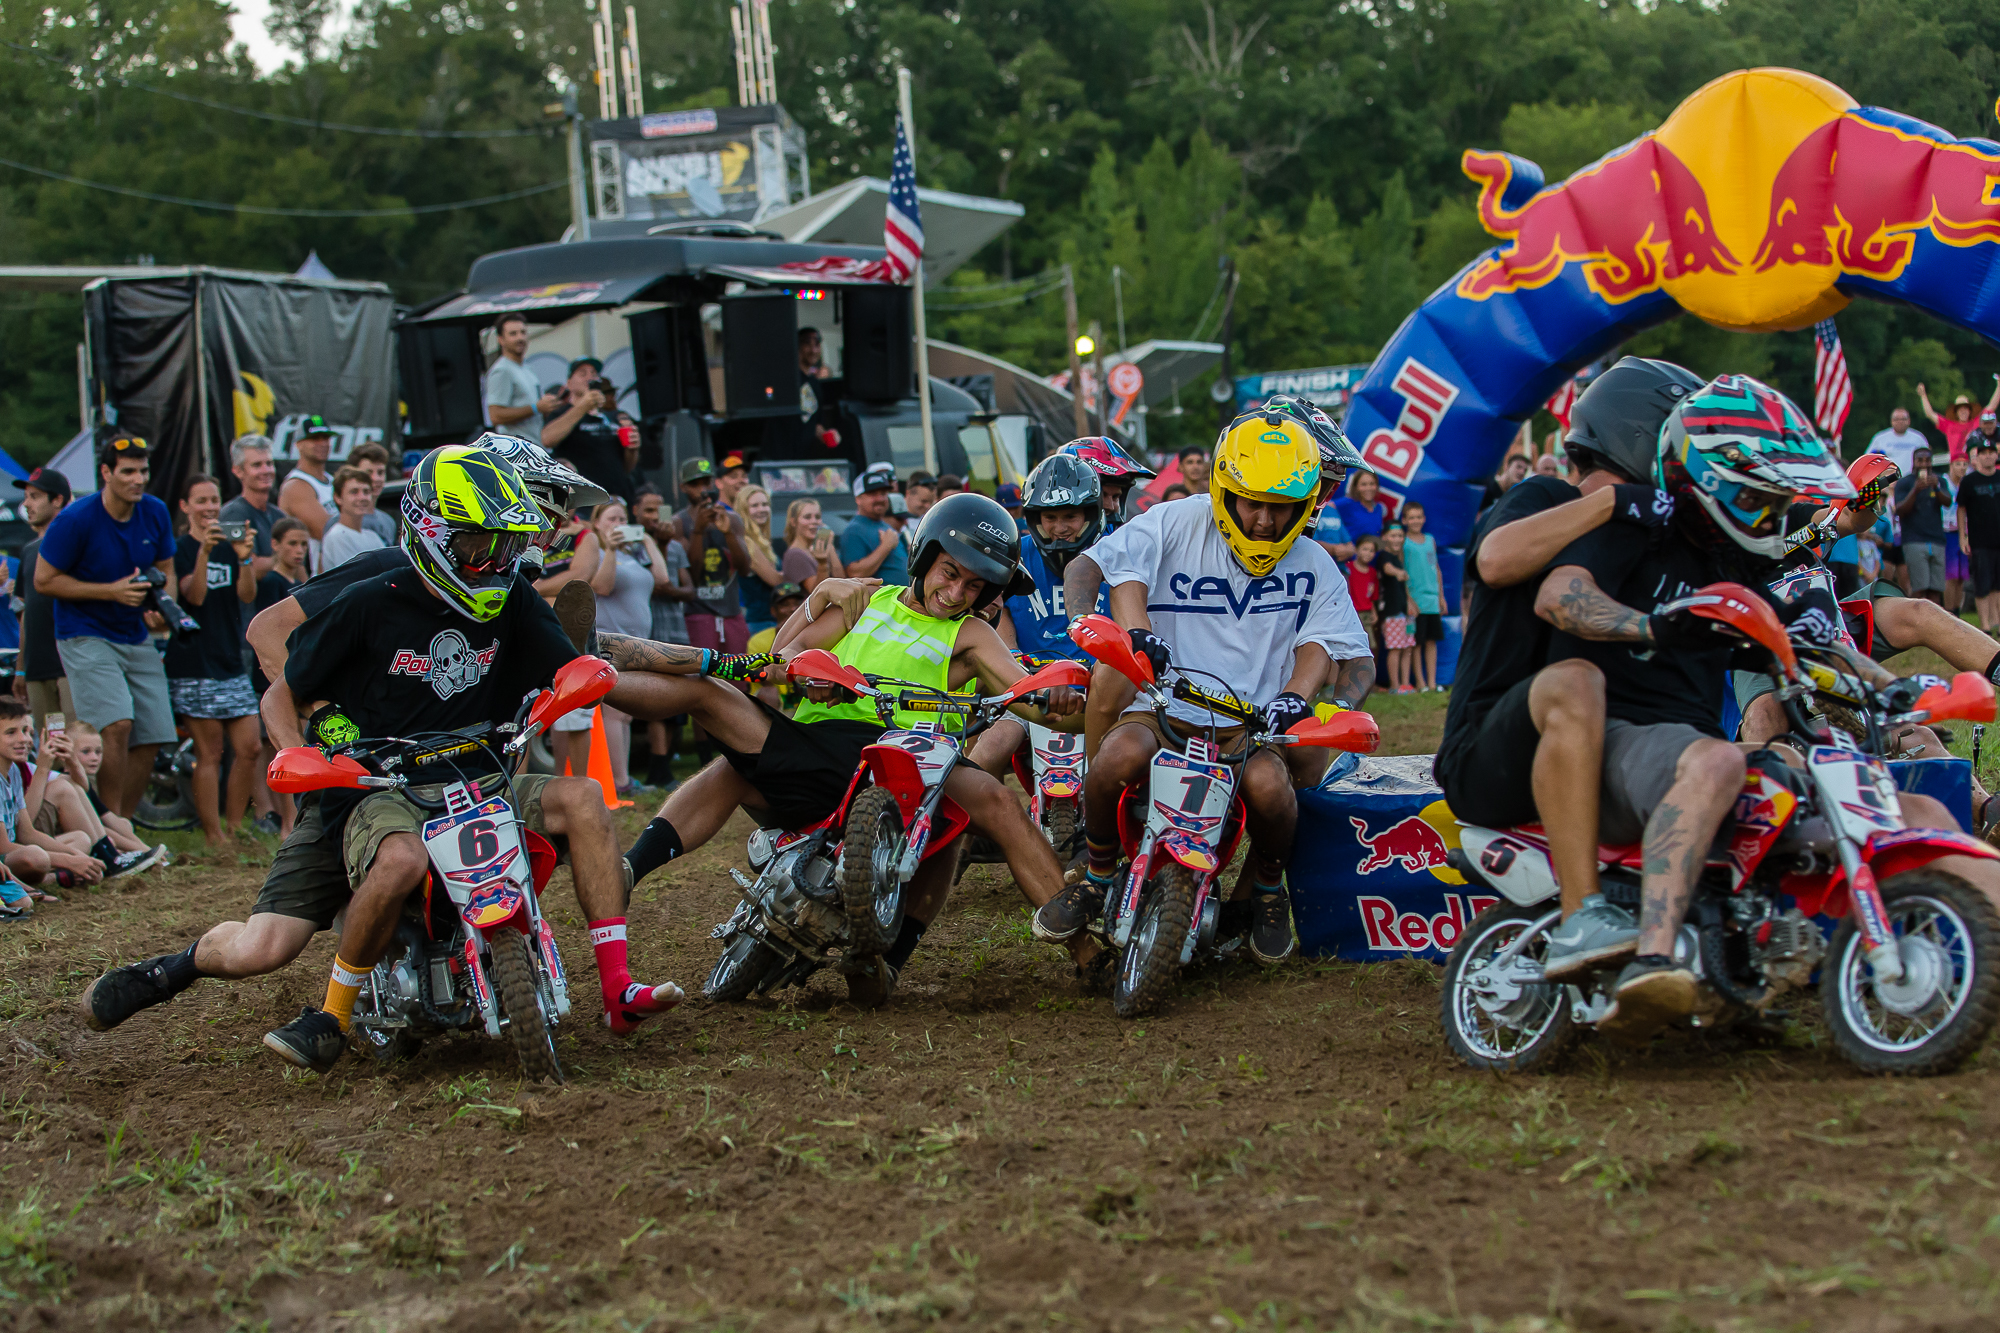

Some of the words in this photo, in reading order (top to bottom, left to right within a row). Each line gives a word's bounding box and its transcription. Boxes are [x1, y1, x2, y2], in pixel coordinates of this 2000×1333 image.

[1261, 369, 1349, 396] FINISH
[1264, 434, 1287, 443] BELL
[1360, 358, 1457, 484] Bull
[978, 521, 1010, 542] HJC
[1168, 571, 1317, 634] seven
[901, 737, 935, 762] 2
[1048, 730, 1077, 754] 3
[1179, 774, 1213, 816] 1
[458, 819, 499, 867] 6
[1480, 836, 1529, 877] 5
[1357, 893, 1466, 951] Red
